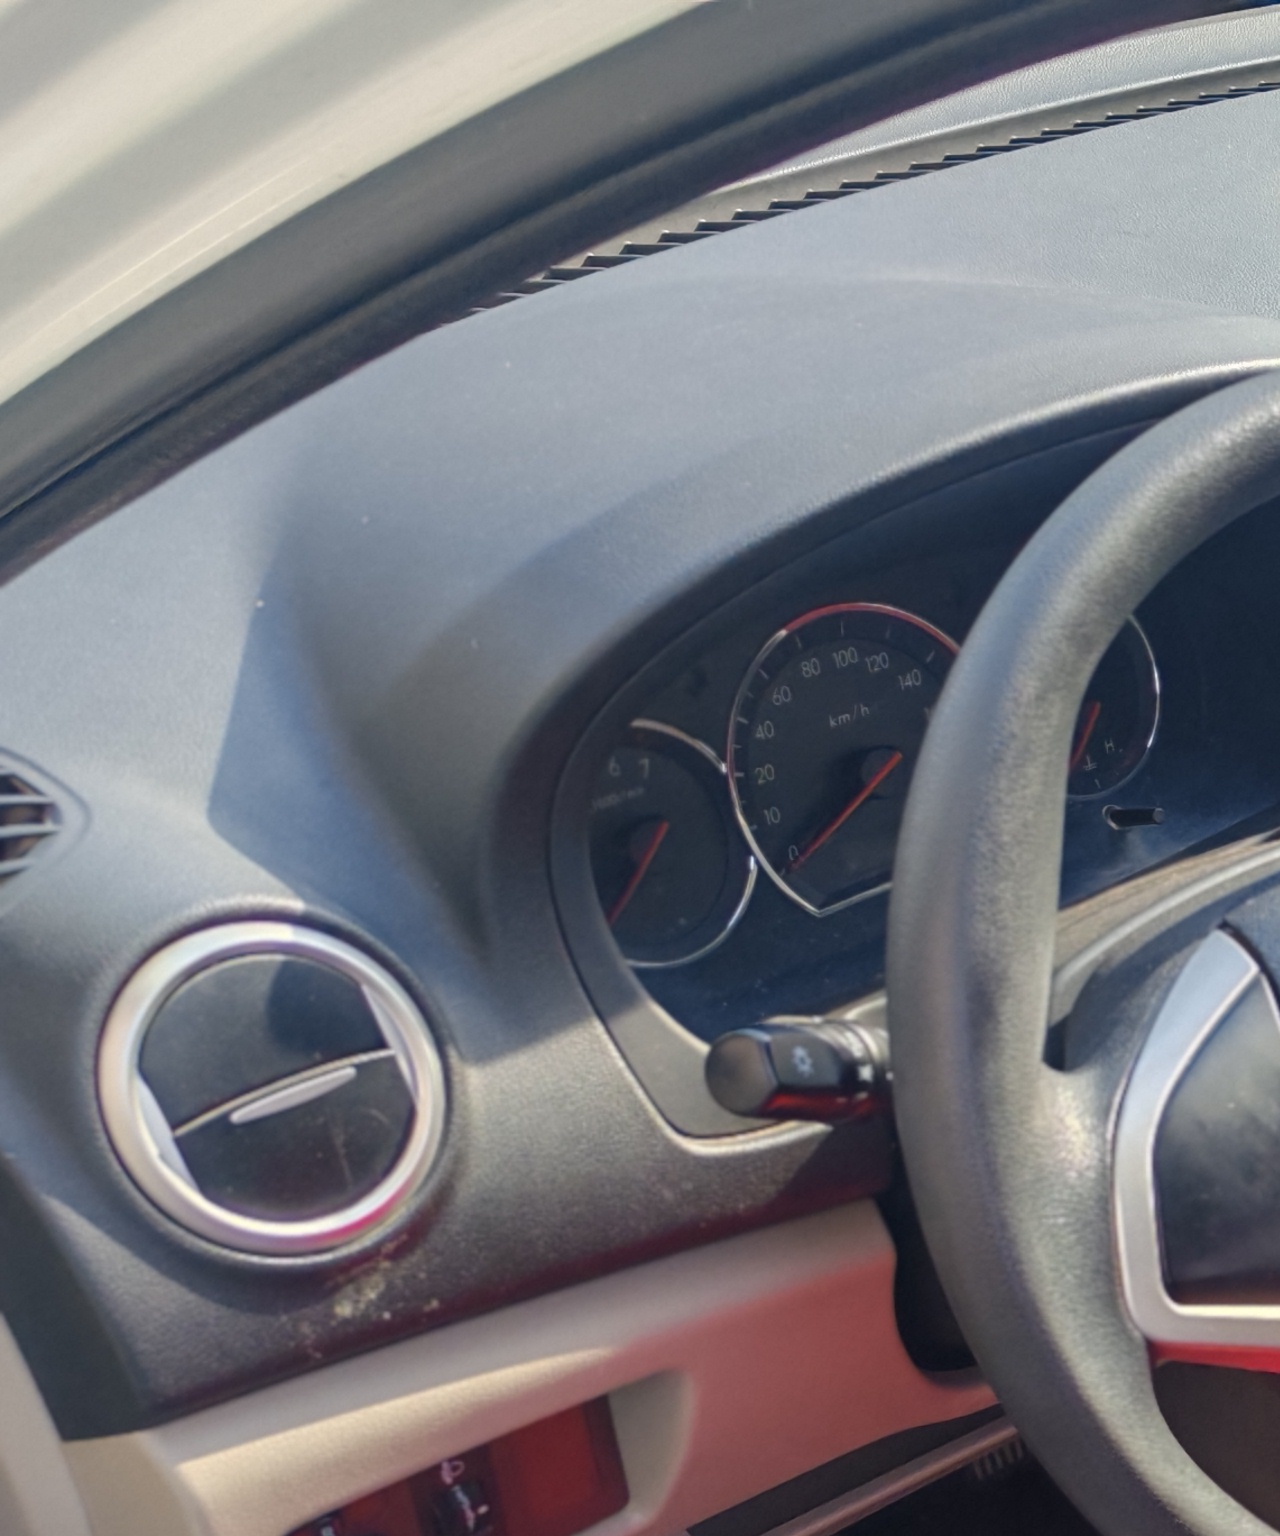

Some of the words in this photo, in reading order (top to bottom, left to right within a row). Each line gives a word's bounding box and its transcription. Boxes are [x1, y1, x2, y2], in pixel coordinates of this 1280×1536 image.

[801, 657, 822, 679] 80
[832, 646, 859, 669] 100
[864, 651, 890, 674] 120
[898, 668, 922, 691] 140
[772, 685, 792, 706] 60
[829, 703, 870, 728] km/h
[755, 719, 775, 741] 40
[754, 763, 775, 785] 20
[763, 806, 781, 826] 10
